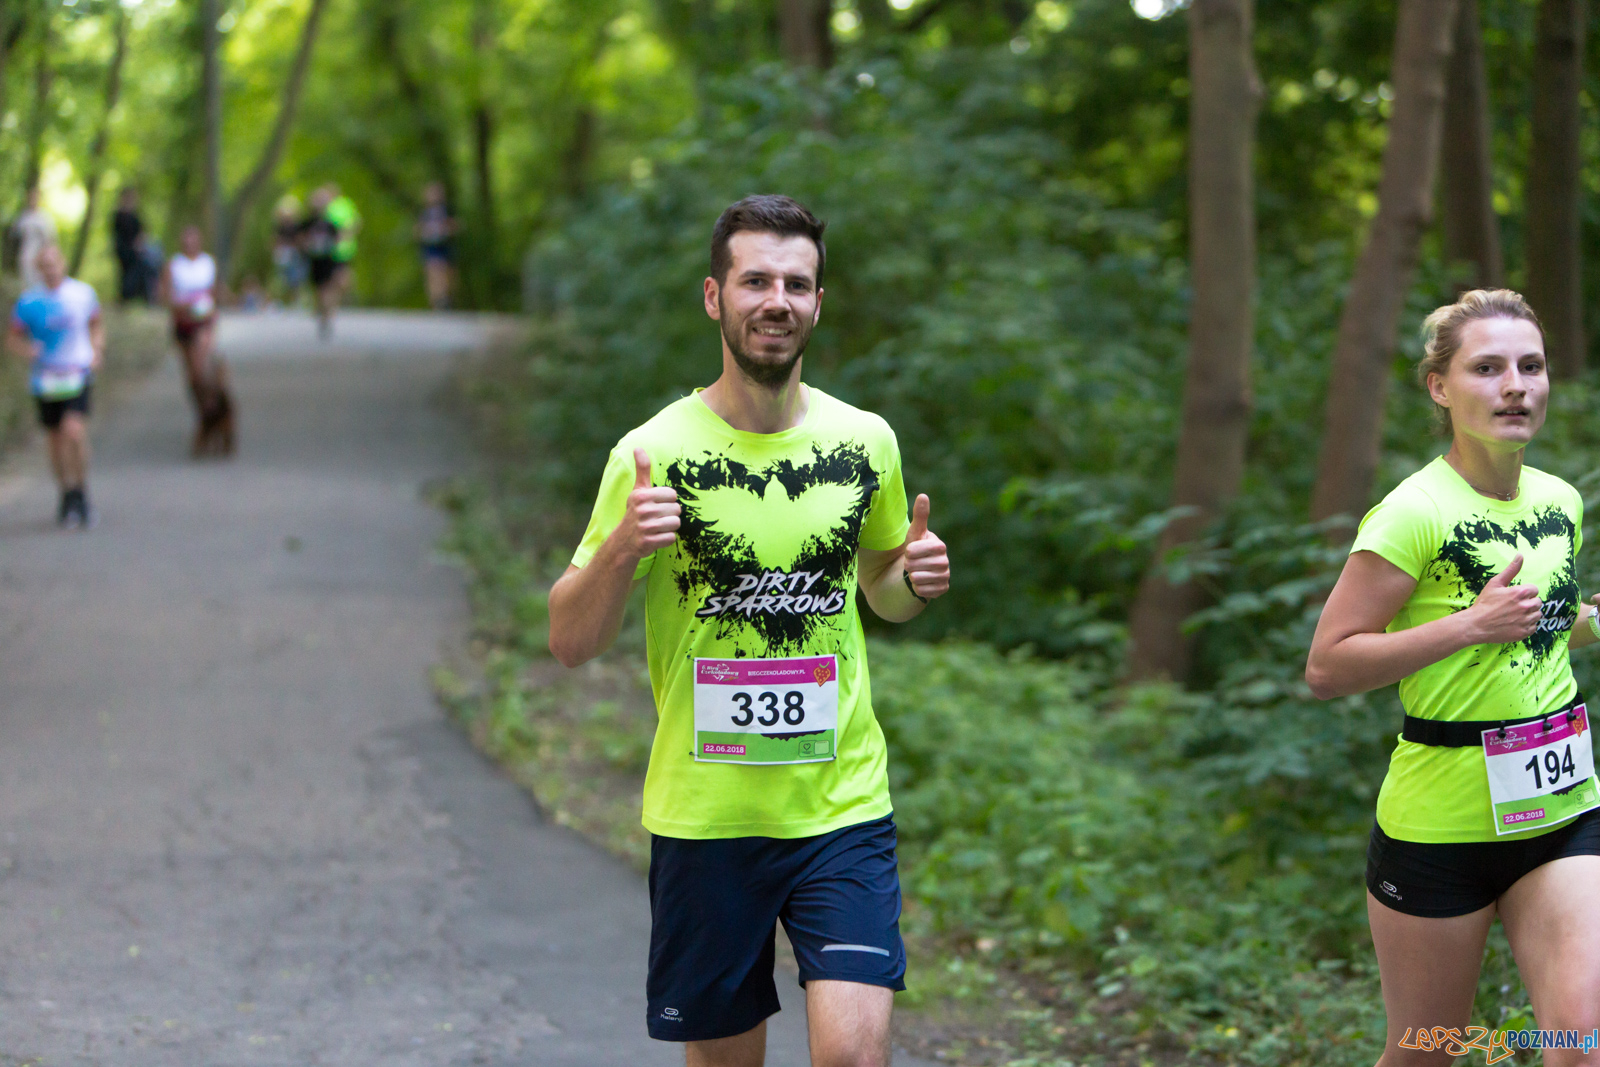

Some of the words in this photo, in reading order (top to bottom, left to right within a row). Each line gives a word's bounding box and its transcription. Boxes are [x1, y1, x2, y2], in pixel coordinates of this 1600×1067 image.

[729, 568, 825, 595] DIRTY
[697, 590, 846, 618] SPARROWS
[731, 690, 805, 727] 338
[704, 745, 744, 754] 22.06.2018
[1525, 744, 1575, 789] 194
[1504, 810, 1544, 823] 22.06.2018
